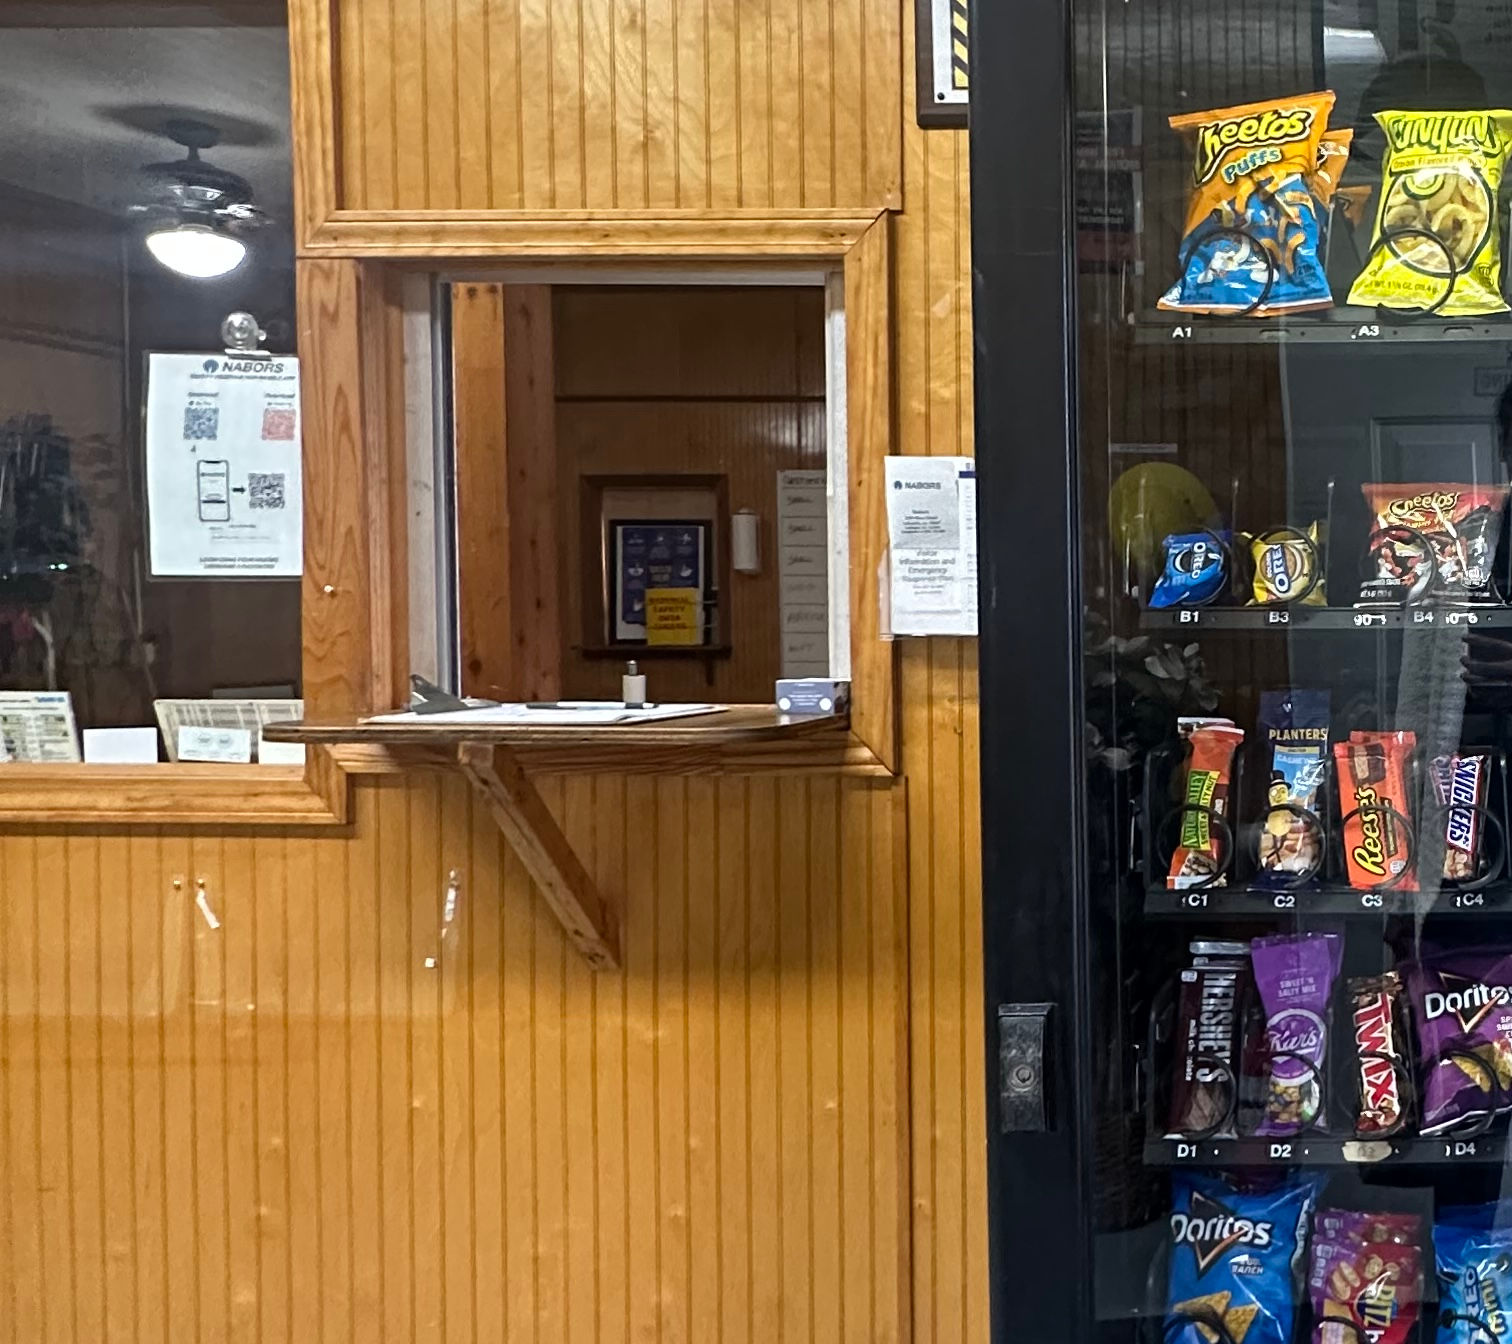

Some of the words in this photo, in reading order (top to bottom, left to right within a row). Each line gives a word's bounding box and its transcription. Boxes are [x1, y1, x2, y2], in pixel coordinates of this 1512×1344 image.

[1223, 149, 1282, 183] Puffs
[1172, 327, 1192, 338] A1
[1358, 325, 1380, 337] A3
[222, 362, 284, 373] NABORS
[905, 480, 941, 490] NABORS
[1391, 492, 1456, 518] Cheetos
[942, 557, 956, 565] and
[1191, 542, 1206, 579] OREO
[908, 566, 947, 576] Emergency
[1180, 611, 1200, 623] B1
[1269, 611, 1289, 623] B3
[1413, 611, 1434, 623] B4
[1269, 728, 1328, 741] PLANTERS
[1188, 893, 1208, 906] C1
[1273, 896, 1295, 907] C2
[1362, 894, 1383, 906] C3
[1463, 893, 1484, 905] C4
[1196, 973, 1236, 1082] HERSHEYS
[1352, 992, 1396, 1111] TWIX
[1177, 1144, 1197, 1157] D1
[1270, 1144, 1292, 1157] D2
[1455, 1143, 1476, 1155] D4
[1171, 1213, 1272, 1246] Doritos
